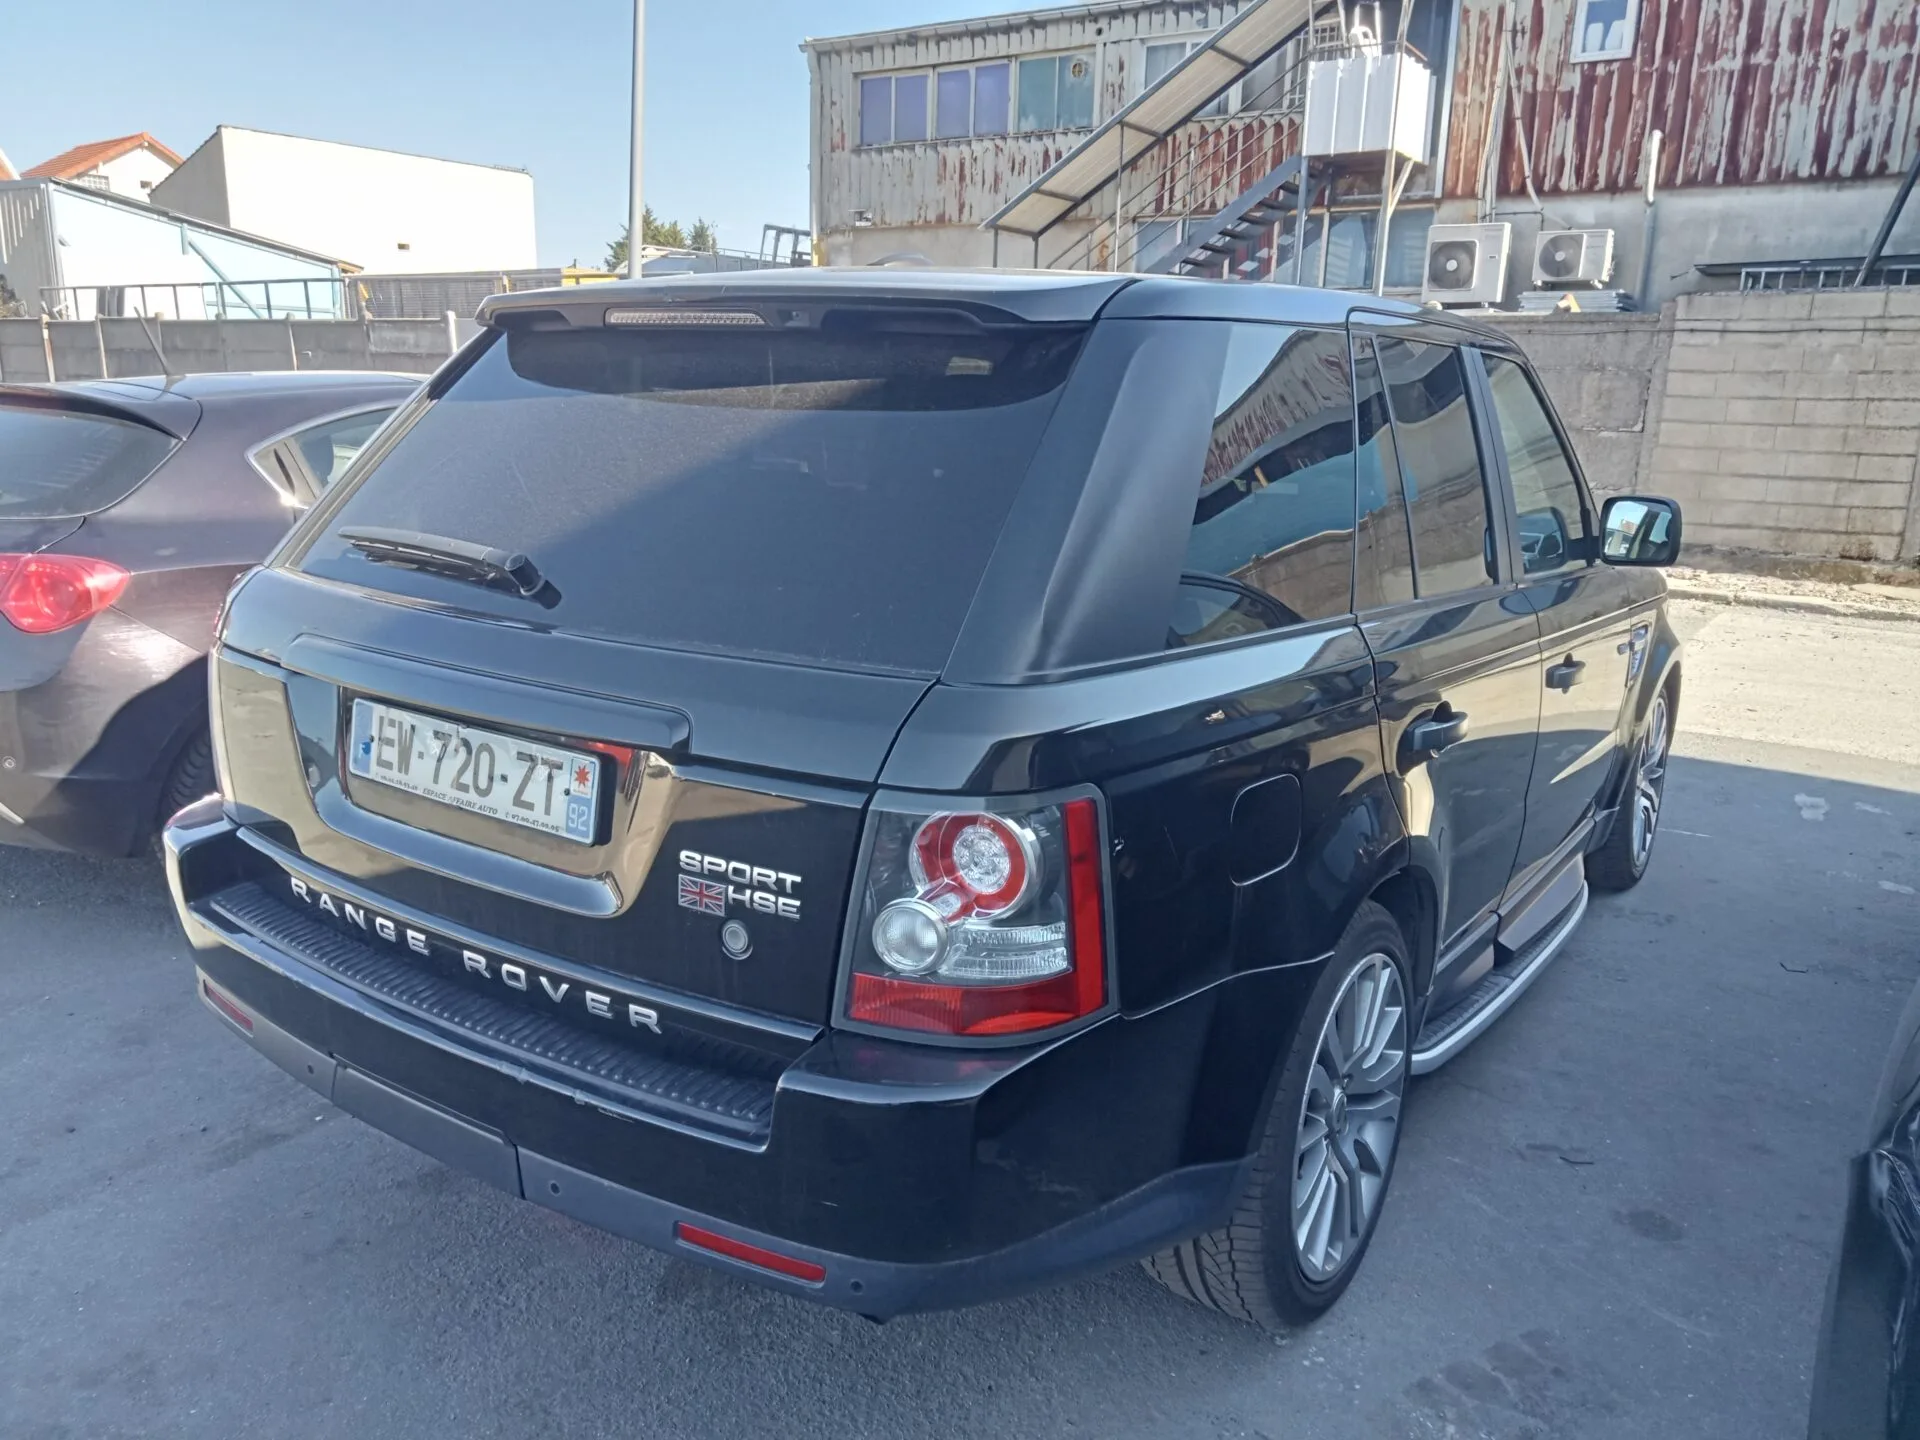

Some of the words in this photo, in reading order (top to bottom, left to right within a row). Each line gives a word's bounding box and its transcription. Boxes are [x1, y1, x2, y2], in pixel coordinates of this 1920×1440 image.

[477, 804, 498, 815] AUTO
[568, 803, 589, 831] 92
[679, 849, 802, 894] SPORT
[727, 885, 801, 919] HSE
[290, 876, 431, 956] RANGE
[462, 950, 662, 1034] ROVER
